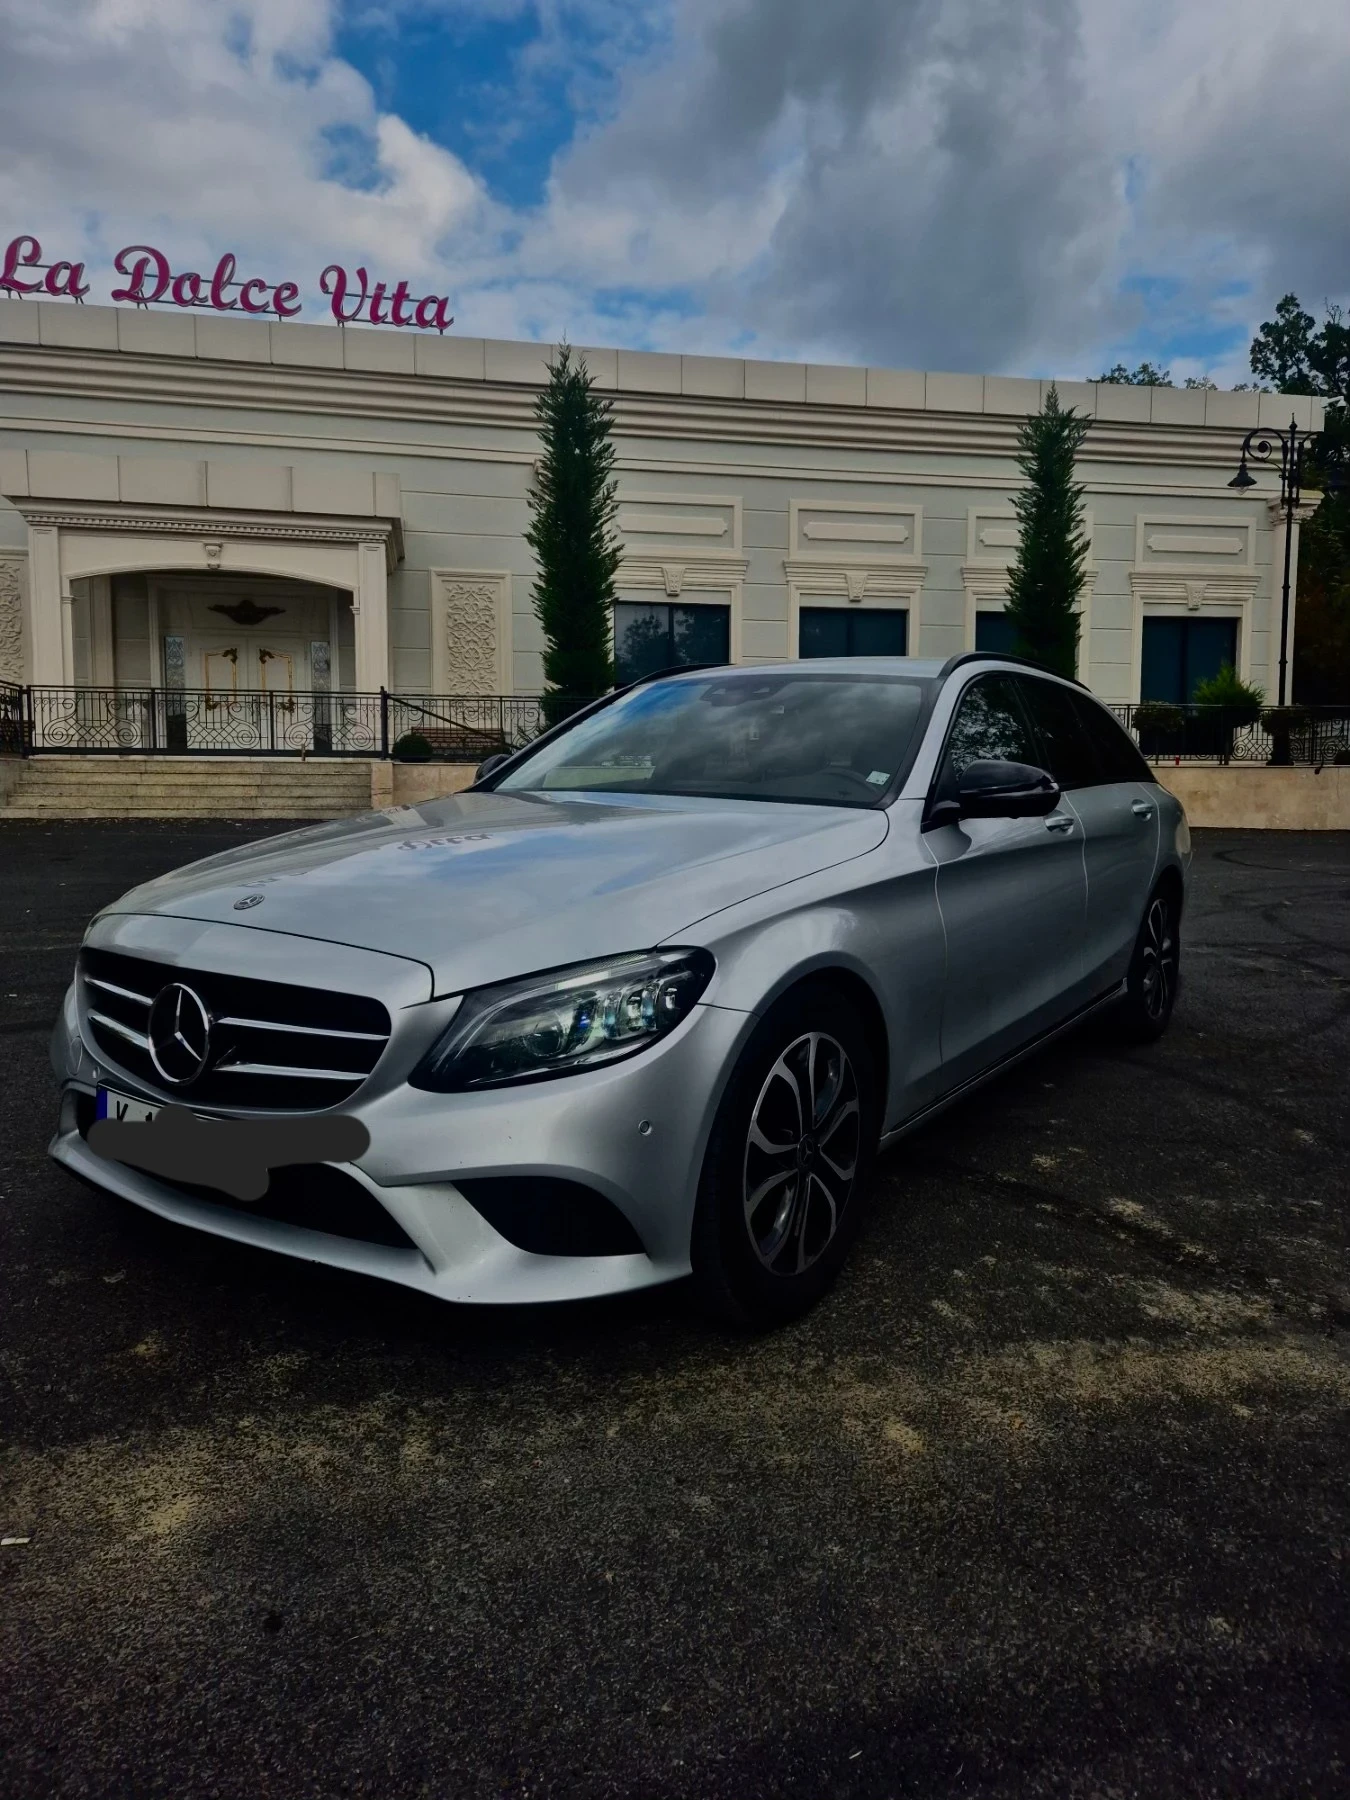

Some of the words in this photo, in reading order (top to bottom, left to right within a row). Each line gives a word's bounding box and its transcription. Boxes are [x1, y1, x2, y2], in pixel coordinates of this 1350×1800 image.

[0, 235, 90, 298] La
[111, 245, 302, 318] Dolce
[320, 264, 454, 331] Vita
